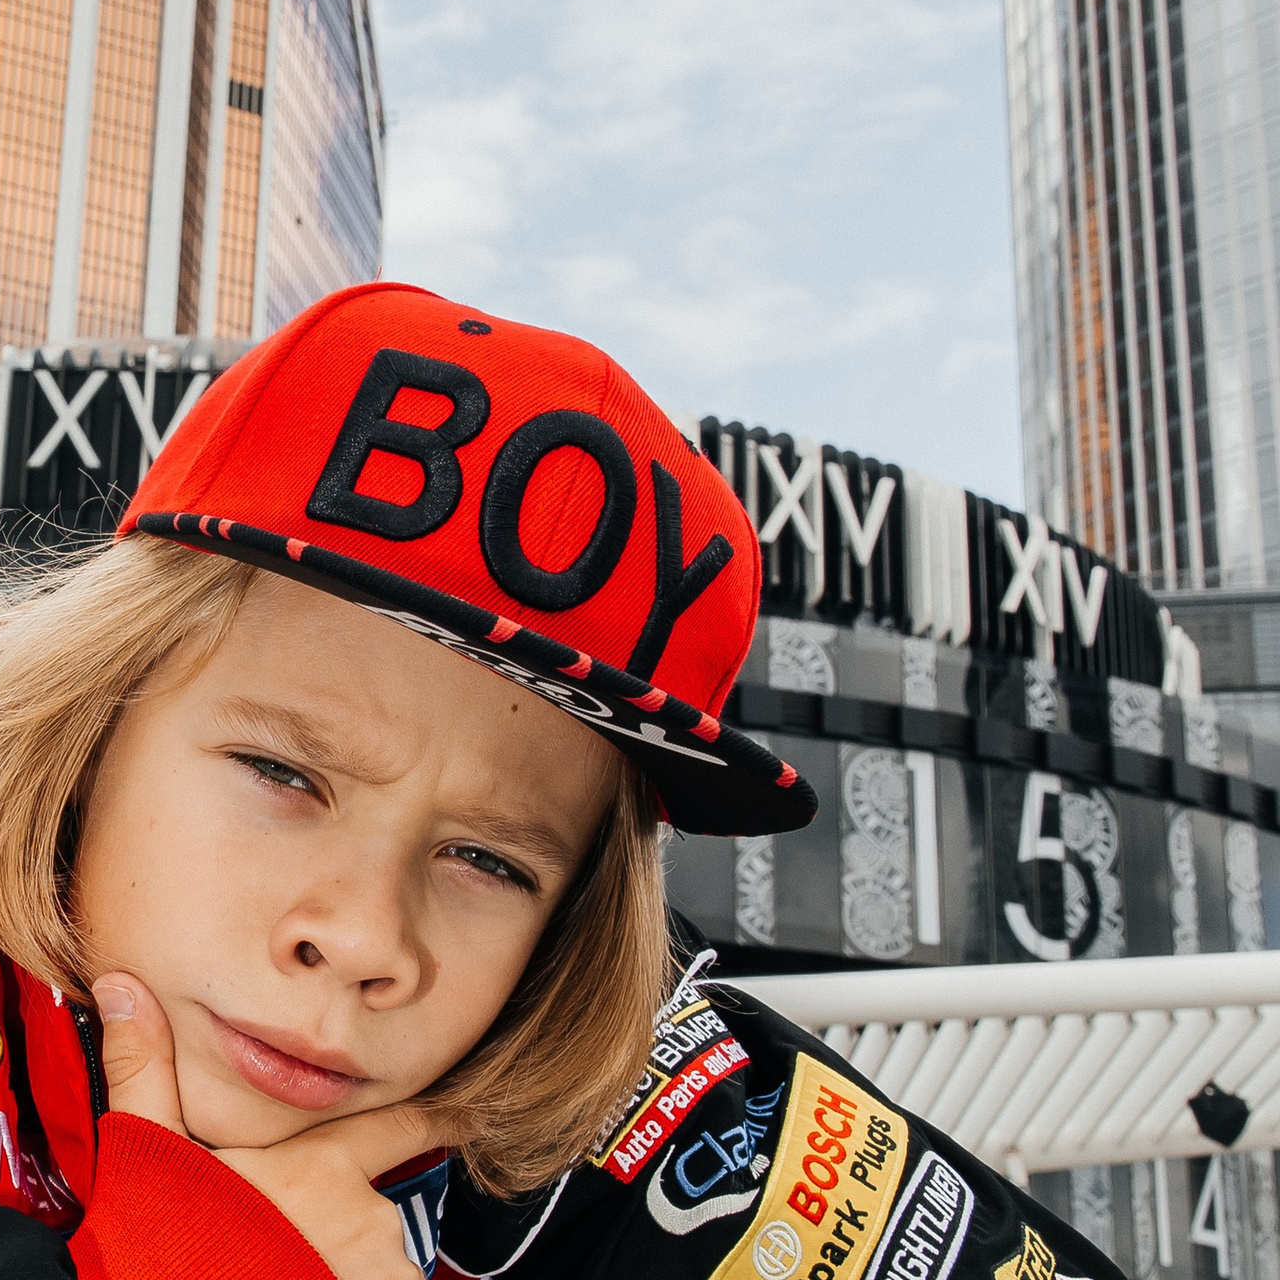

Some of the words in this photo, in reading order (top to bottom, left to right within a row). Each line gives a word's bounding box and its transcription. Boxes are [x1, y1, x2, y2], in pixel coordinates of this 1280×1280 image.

[306, 348, 734, 684] BOY
[998, 518, 1108, 649] XIV
[613, 1120, 663, 1174] Auto
[656, 1070, 708, 1121] Parts
[703, 1046, 732, 1076] and
[787, 1084, 858, 1227] BOSCH
[849, 1114, 897, 1191] Plugs
